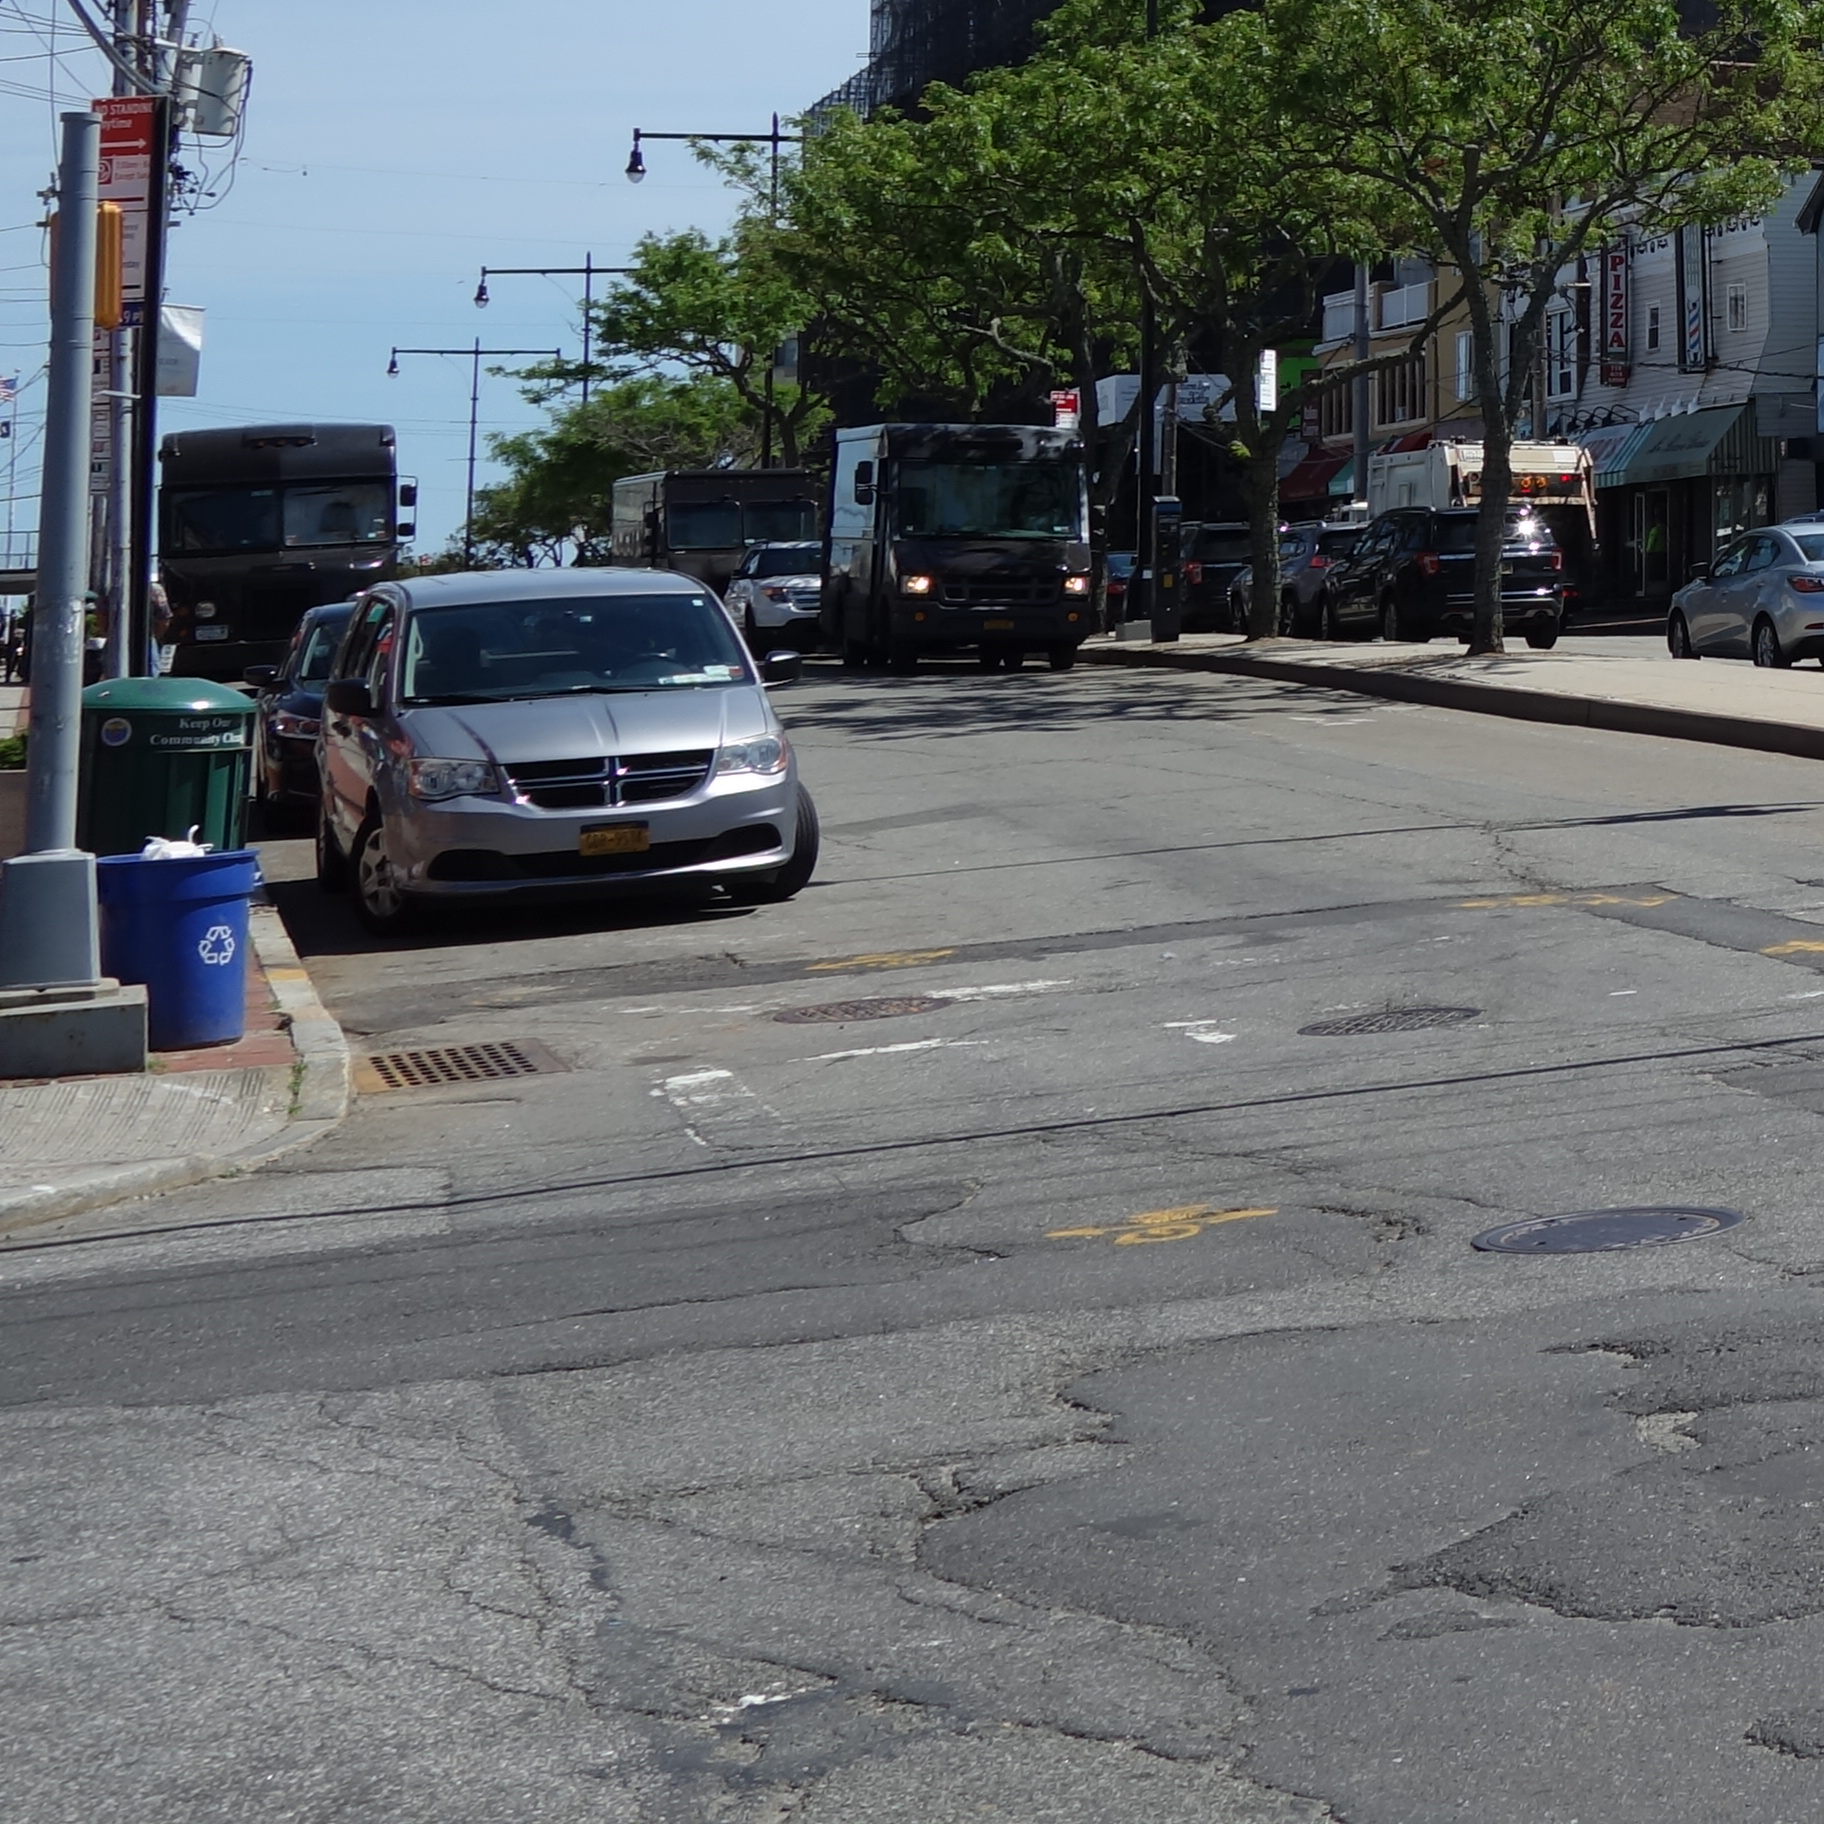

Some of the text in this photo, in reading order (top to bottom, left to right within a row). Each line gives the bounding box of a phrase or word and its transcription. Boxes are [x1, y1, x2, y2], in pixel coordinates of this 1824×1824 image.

[1609, 255, 1625, 348] PIZZA
[180, 717, 233, 731] Keep Our
[150, 734, 221, 747] Community
